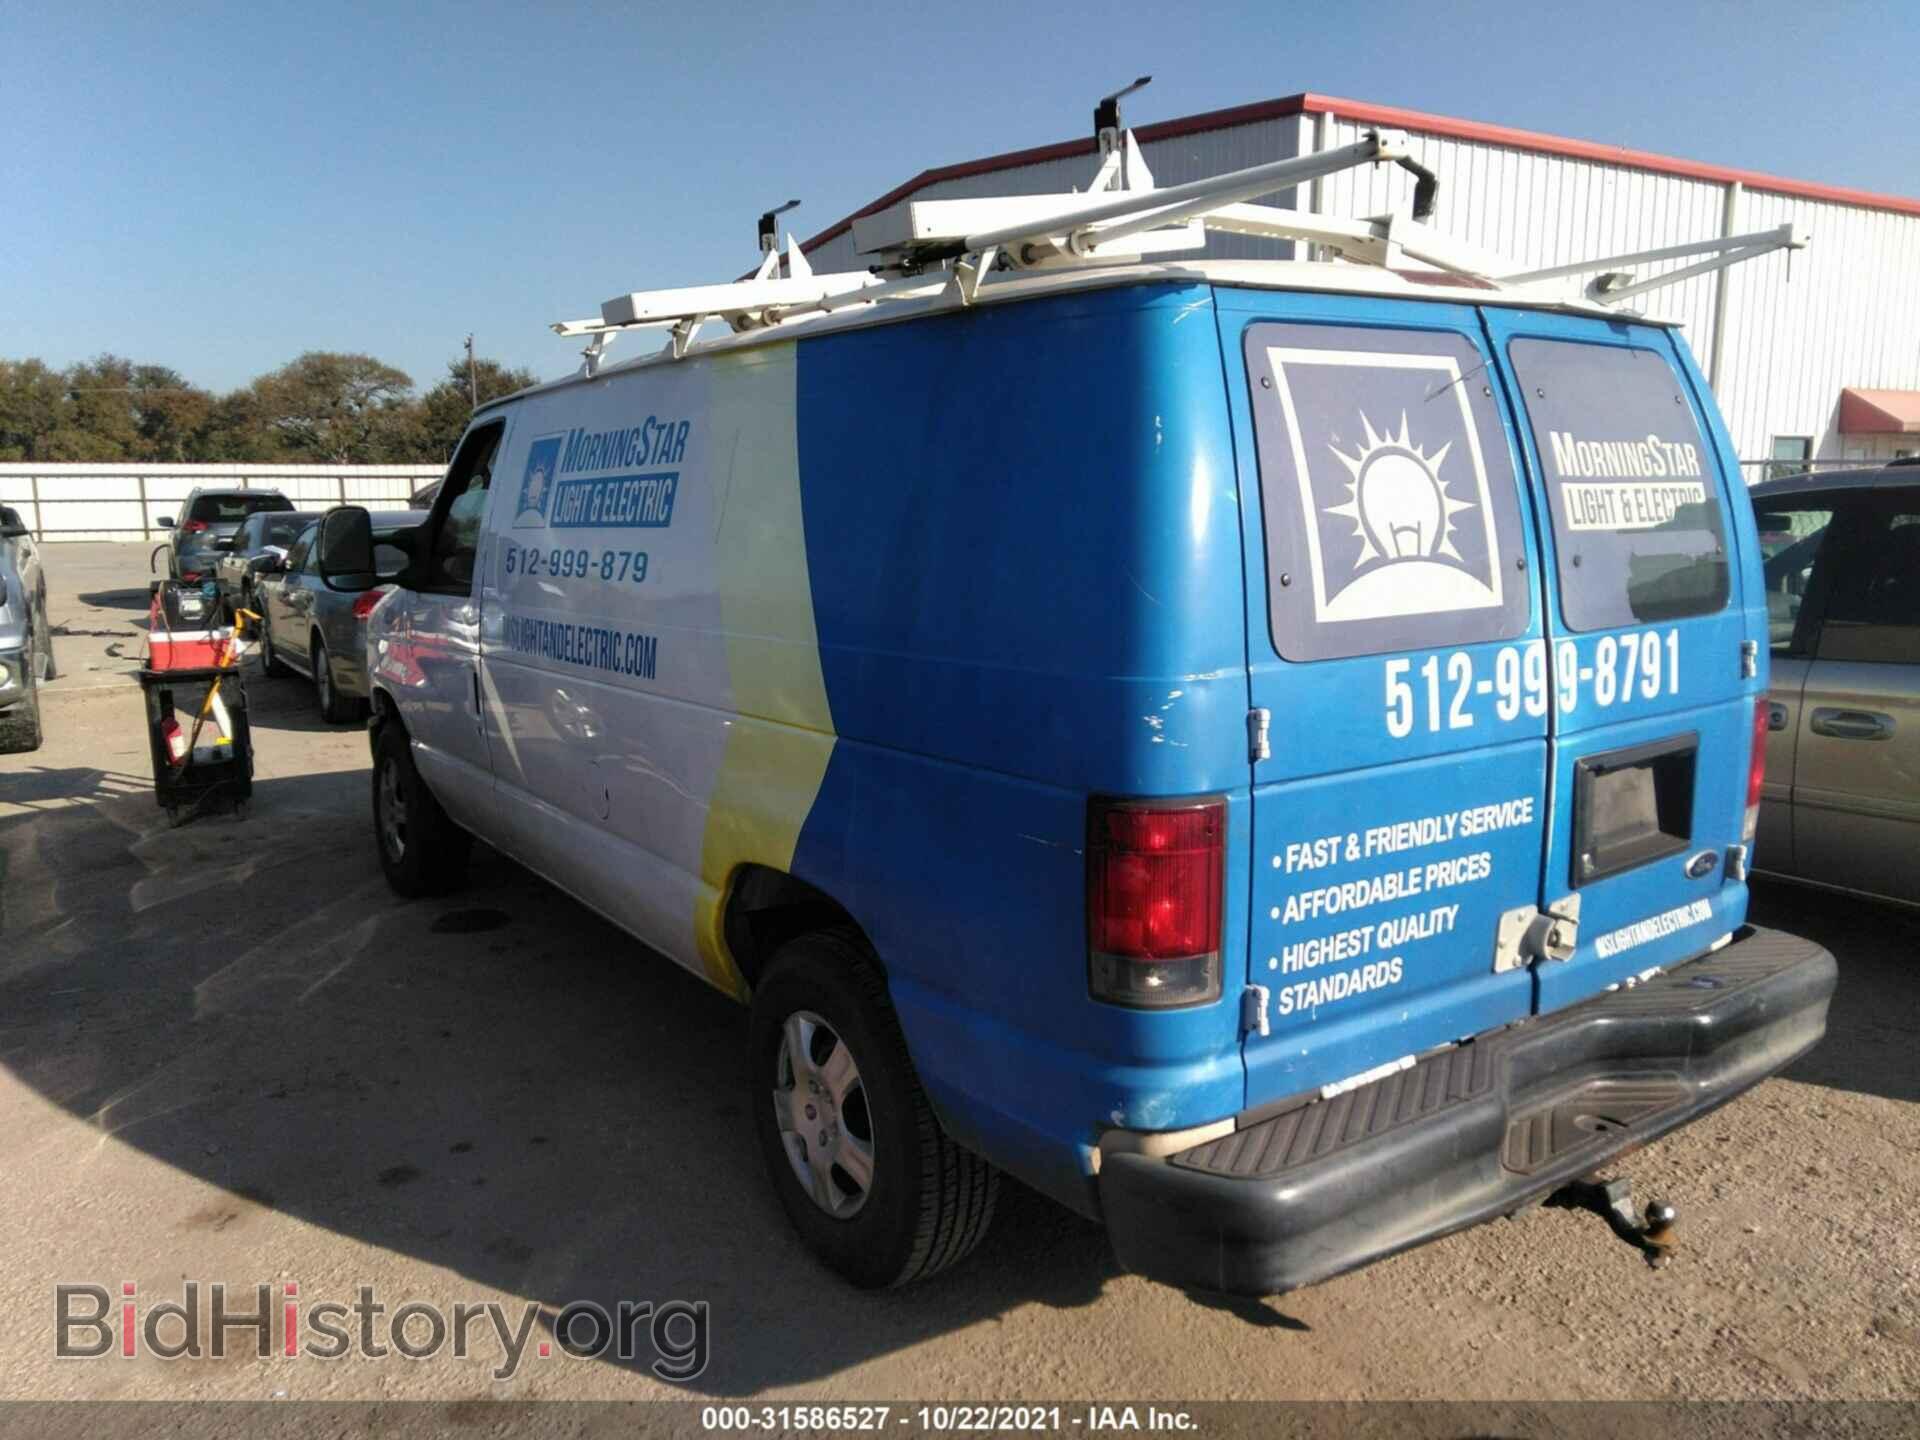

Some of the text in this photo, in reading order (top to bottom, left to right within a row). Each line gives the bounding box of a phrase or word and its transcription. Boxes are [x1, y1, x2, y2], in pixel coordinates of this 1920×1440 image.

[553, 478, 673, 523] LIGHT & ELECTRIC
[1568, 488, 1617, 524] LIGHT
[1620, 488, 1633, 523] &
[506, 548, 649, 582] 512-999-879
[1385, 628, 1679, 738] 512-999-8791
[1286, 797, 1534, 873] FAST & FRIENDLY SERVICE
[1282, 852, 1491, 925] AFFORDABLE PRICES
[1282, 904, 1459, 974] HIGHEST QUALITY
[1279, 957, 1403, 1015] STANDARDS
